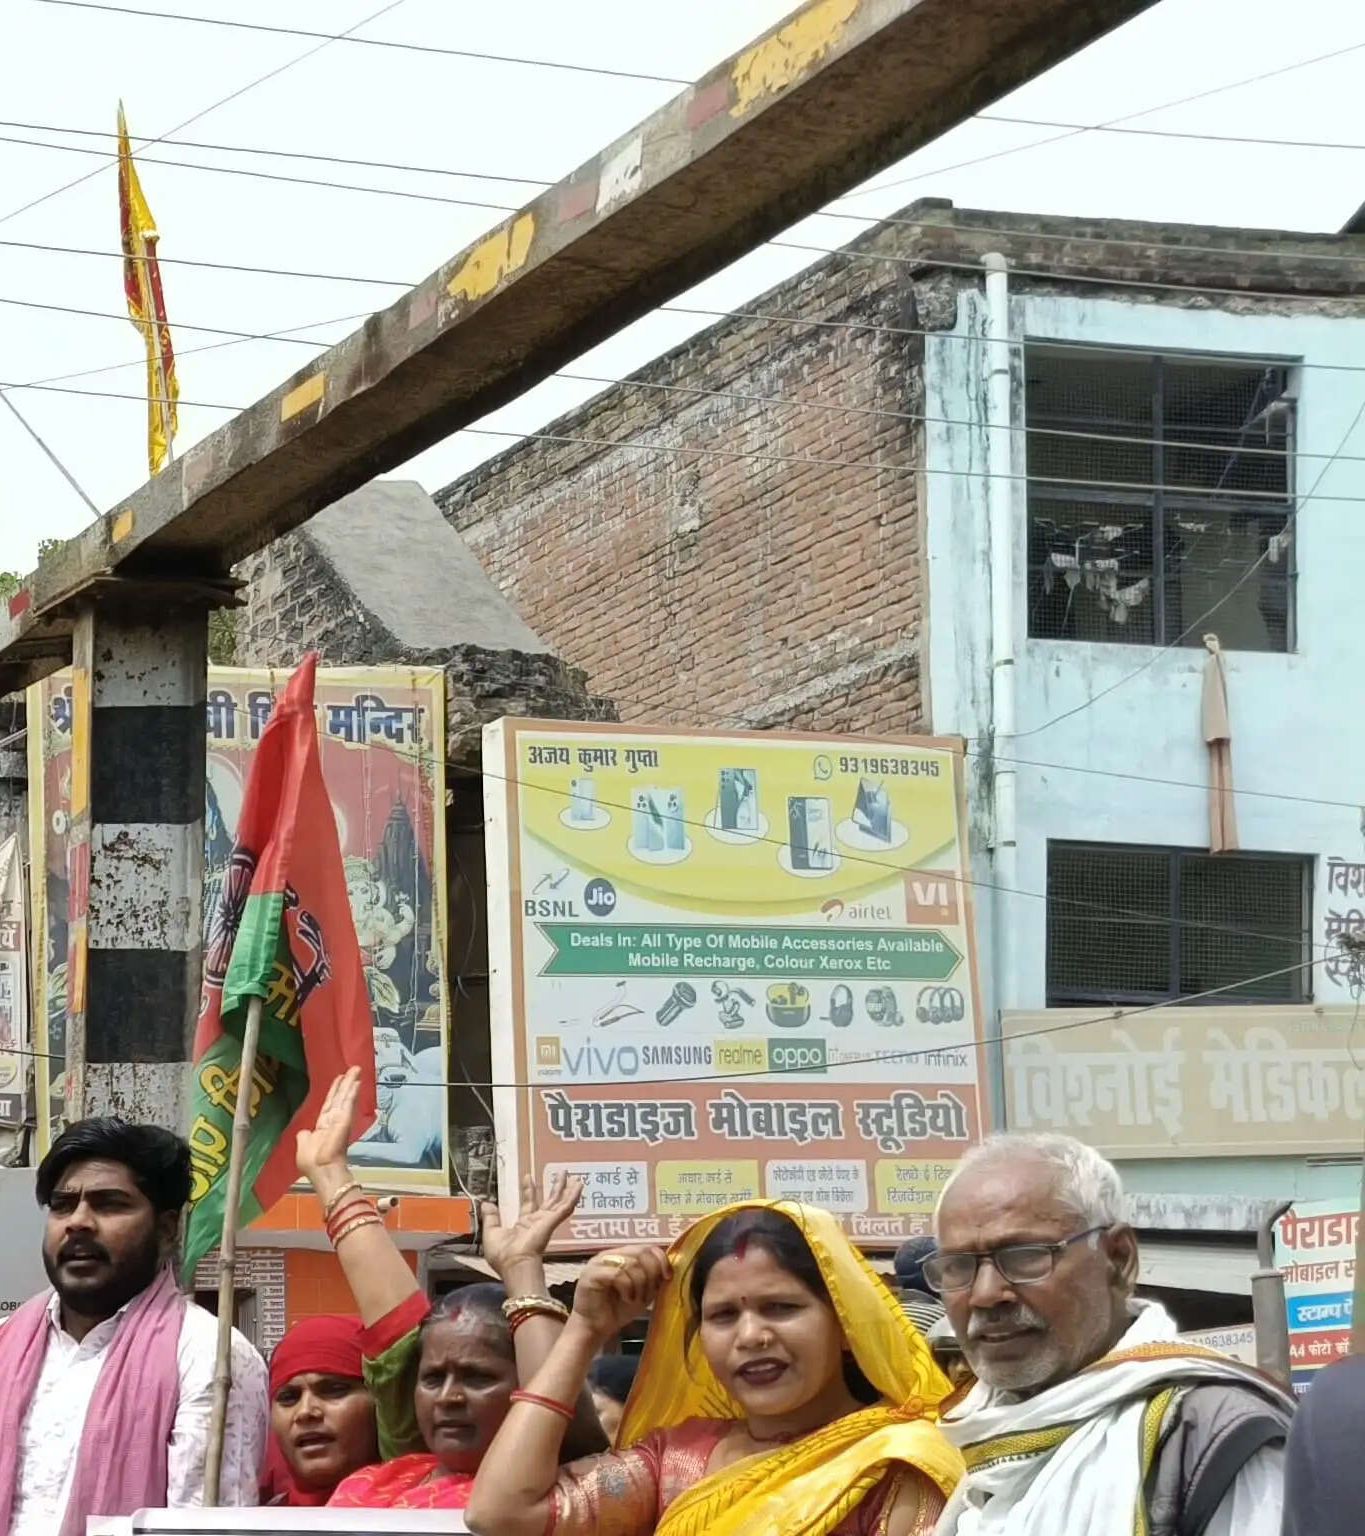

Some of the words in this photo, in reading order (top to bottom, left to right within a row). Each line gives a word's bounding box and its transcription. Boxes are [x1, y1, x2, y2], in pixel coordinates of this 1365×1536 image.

[529, 746, 569, 765] अजय
[578, 748, 617, 772] कुमार
[624, 749, 659, 773] गुप्ता
[840, 757, 939, 777] 9319638345
[587, 887, 615, 906] Jio
[525, 900, 579, 918] BSNL
[849, 903, 892, 920] airtel
[570, 932, 613, 947] Deals
[617, 933, 637, 948] In:
[641, 933, 661, 948] All
[667, 934, 701, 951] Type
[706, 934, 726, 949] Of
[728, 934, 778, 949] Mobile
[781, 935, 873, 951] Accessories
[877, 937, 944, 953] Available
[629, 953, 679, 967] Mobile
[684, 953, 760, 971] Recharge,
[764, 954, 814, 969] Colour
[820, 955, 862, 970] Xerox
[867, 956, 891, 970] Etc
[562, 1036, 639, 1076] vivo
[643, 1045, 712, 1065] SAMSUNG
[718, 1046, 762, 1065] realme
[772, 1047, 821, 1069] oppo
[543, 1091, 697, 1145] पैराडाइज
[710, 1092, 844, 1144] मोबाइल
[855, 1091, 968, 1153] स्टूडियो
[596, 1166, 621, 1185] कार्ड
[626, 1167, 639, 1185] से
[570, 1217, 628, 1238] स्टाम्प
